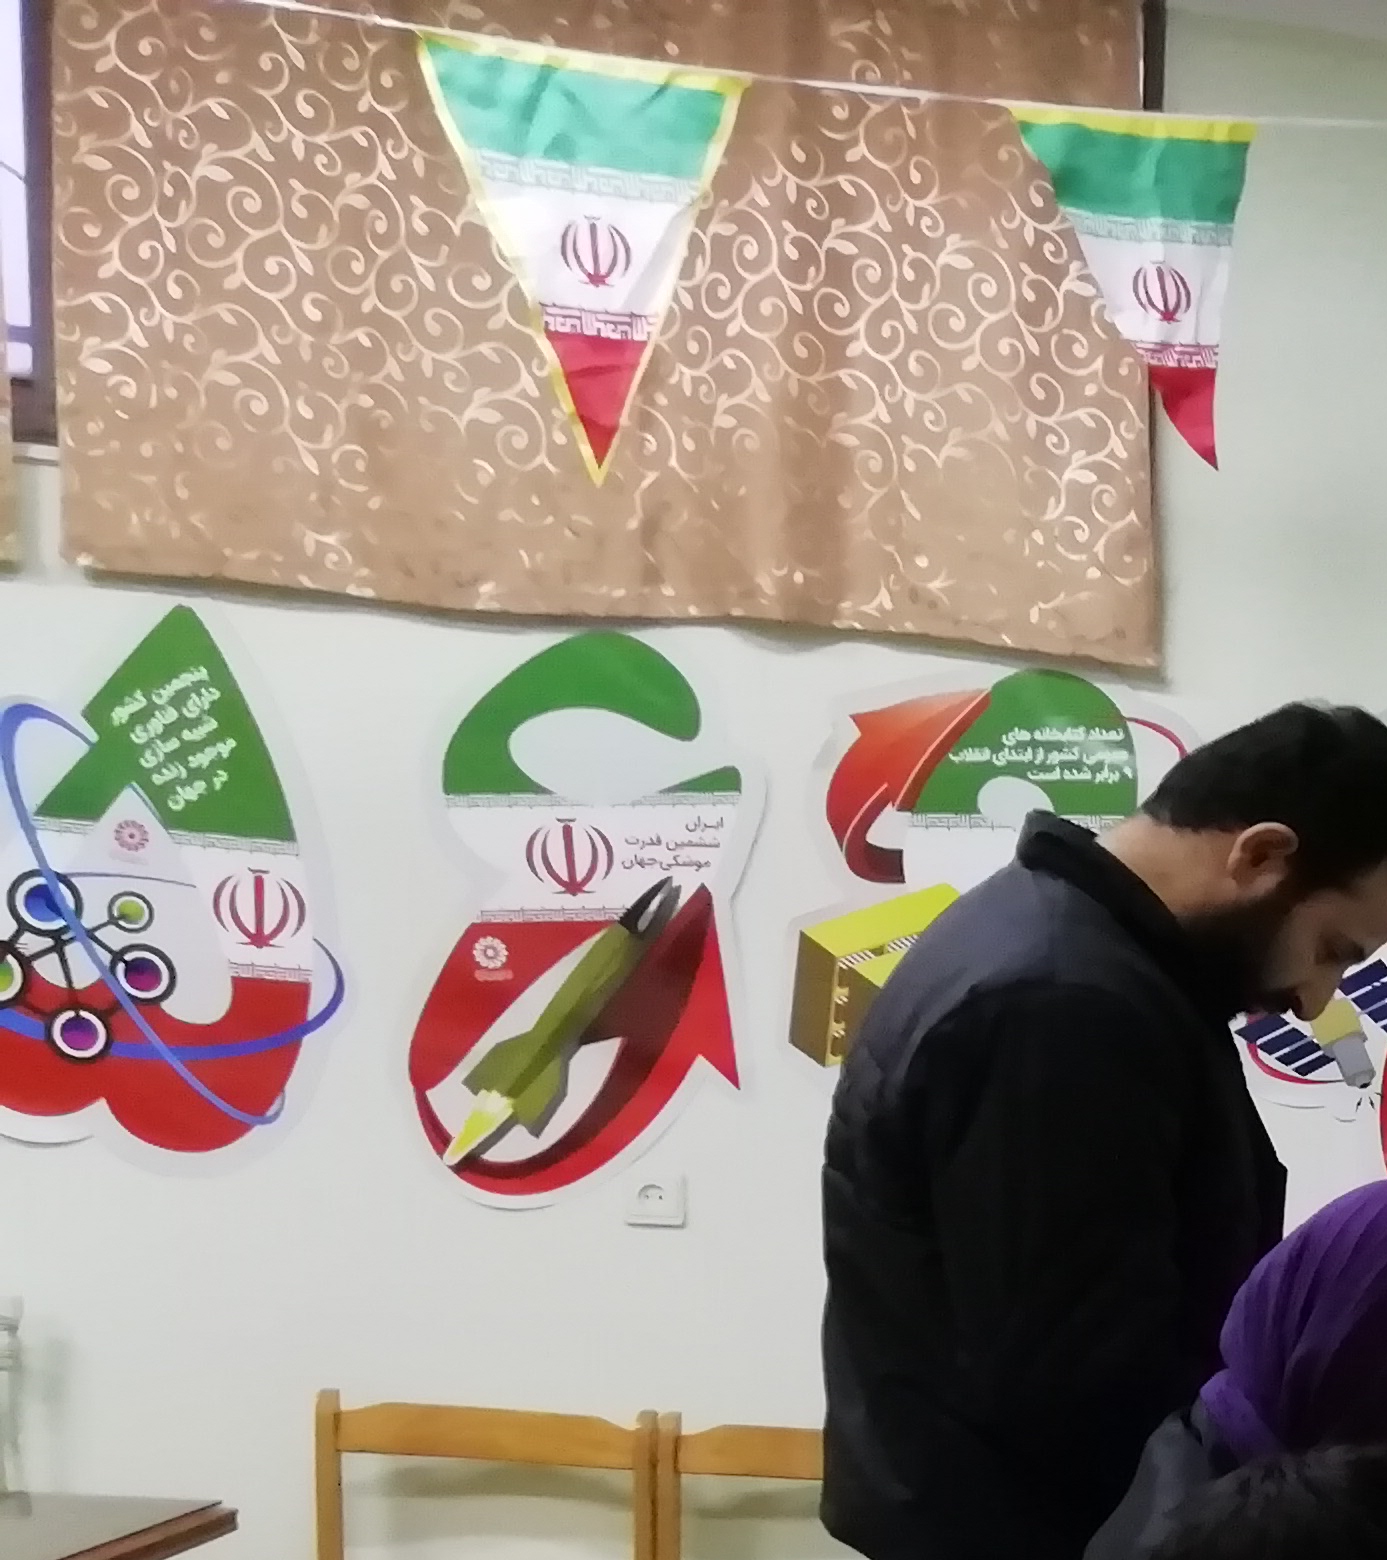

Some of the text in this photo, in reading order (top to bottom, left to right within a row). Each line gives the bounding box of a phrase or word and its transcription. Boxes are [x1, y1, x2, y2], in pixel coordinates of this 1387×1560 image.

[110, 689, 148, 726] کشور
[181, 687, 221, 718] دارای
[1001, 725, 1125, 746] تعداد کتابخانه های
[139, 737, 181, 769] سازی
[948, 746, 991, 764] انقلاب
[992, 746, 1033, 766] ابتدای
[1034, 746, 1045, 765] از
[1046, 746, 1080, 765] کشور
[1026, 765, 1061, 781] است
[1062, 764, 1092, 780] شده
[1094, 763, 1120, 784] برابر
[167, 770, 229, 811] در جهان
[685, 815, 724, 832] ایران
[624, 833, 721, 851] ششمین قدرت
[621, 854, 711, 872] موشکی جهان
